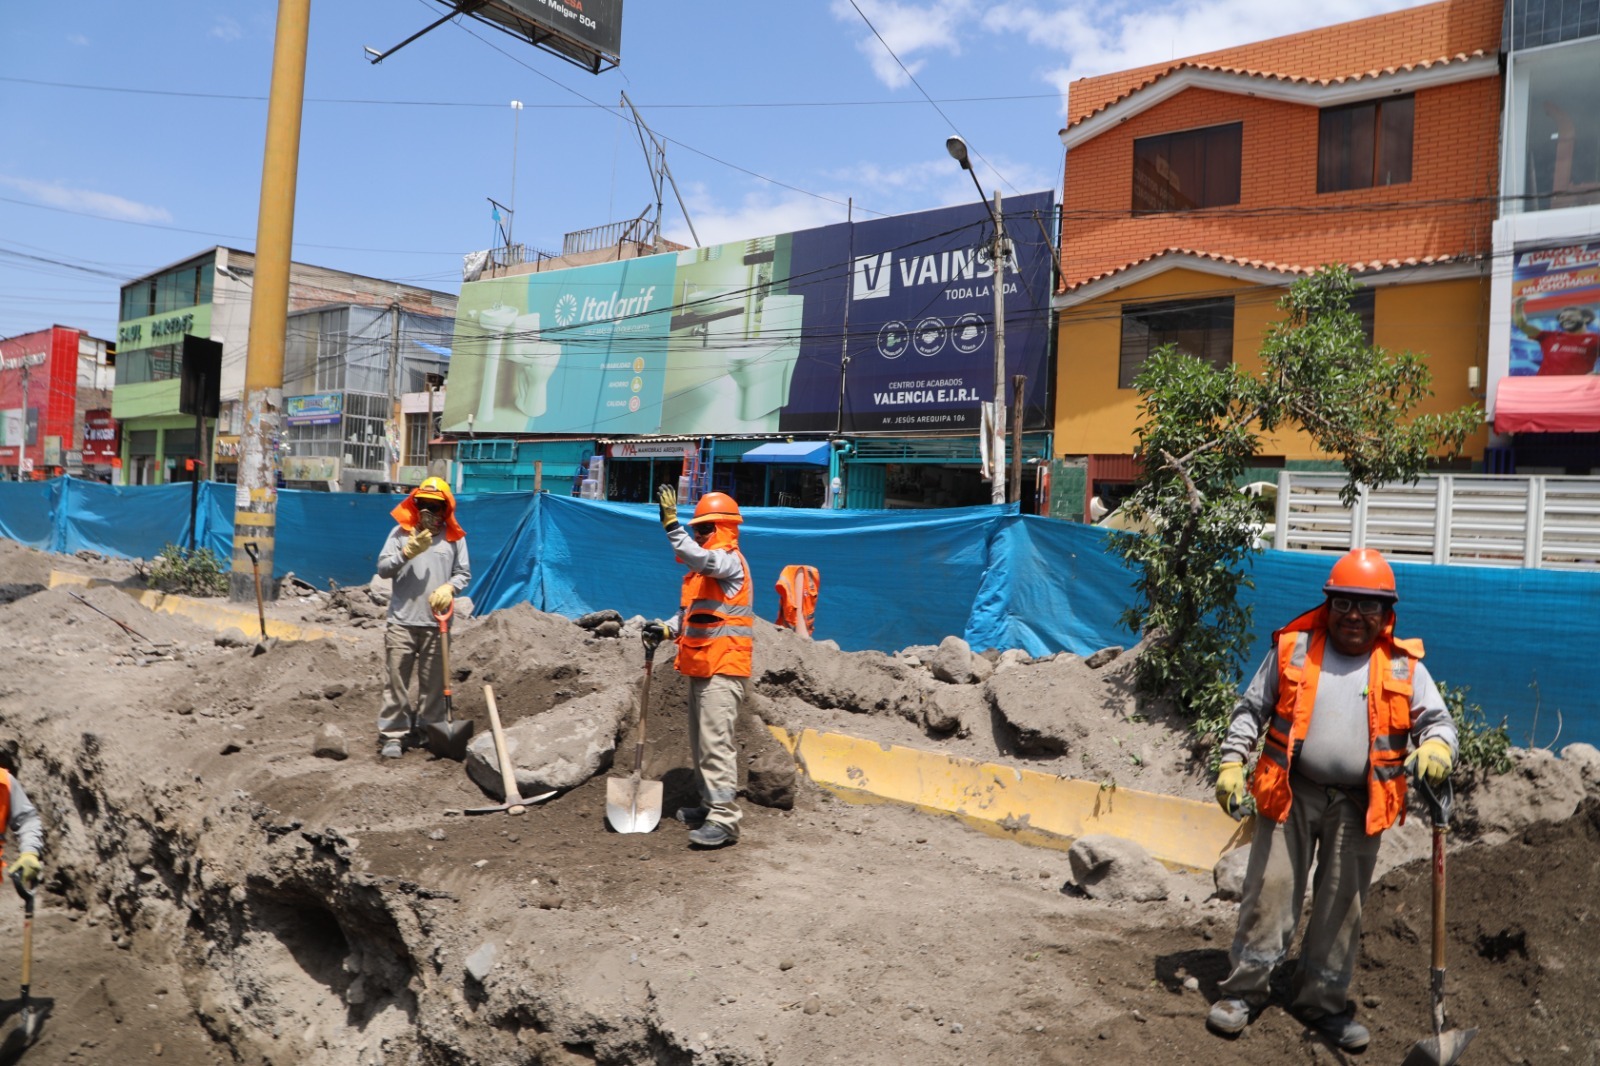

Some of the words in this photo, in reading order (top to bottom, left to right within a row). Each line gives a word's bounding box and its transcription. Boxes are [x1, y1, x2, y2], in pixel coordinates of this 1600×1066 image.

[548, 0, 577, 19] Melgar
[579, 14, 596, 30] 504
[945, 287, 973, 300] TODA
[975, 285, 989, 297] LA
[580, 286, 656, 324] Italgrif
[889, 381, 915, 390] CENTRO
[916, 380, 925, 388] DE
[926, 378, 963, 388] ACABADOS
[873, 390, 935, 405] VALENCIA
[937, 388, 979, 403] E.I.R.L
[895, 415, 915, 424] JESÚS
[917, 415, 951, 423] AREQUIPA
